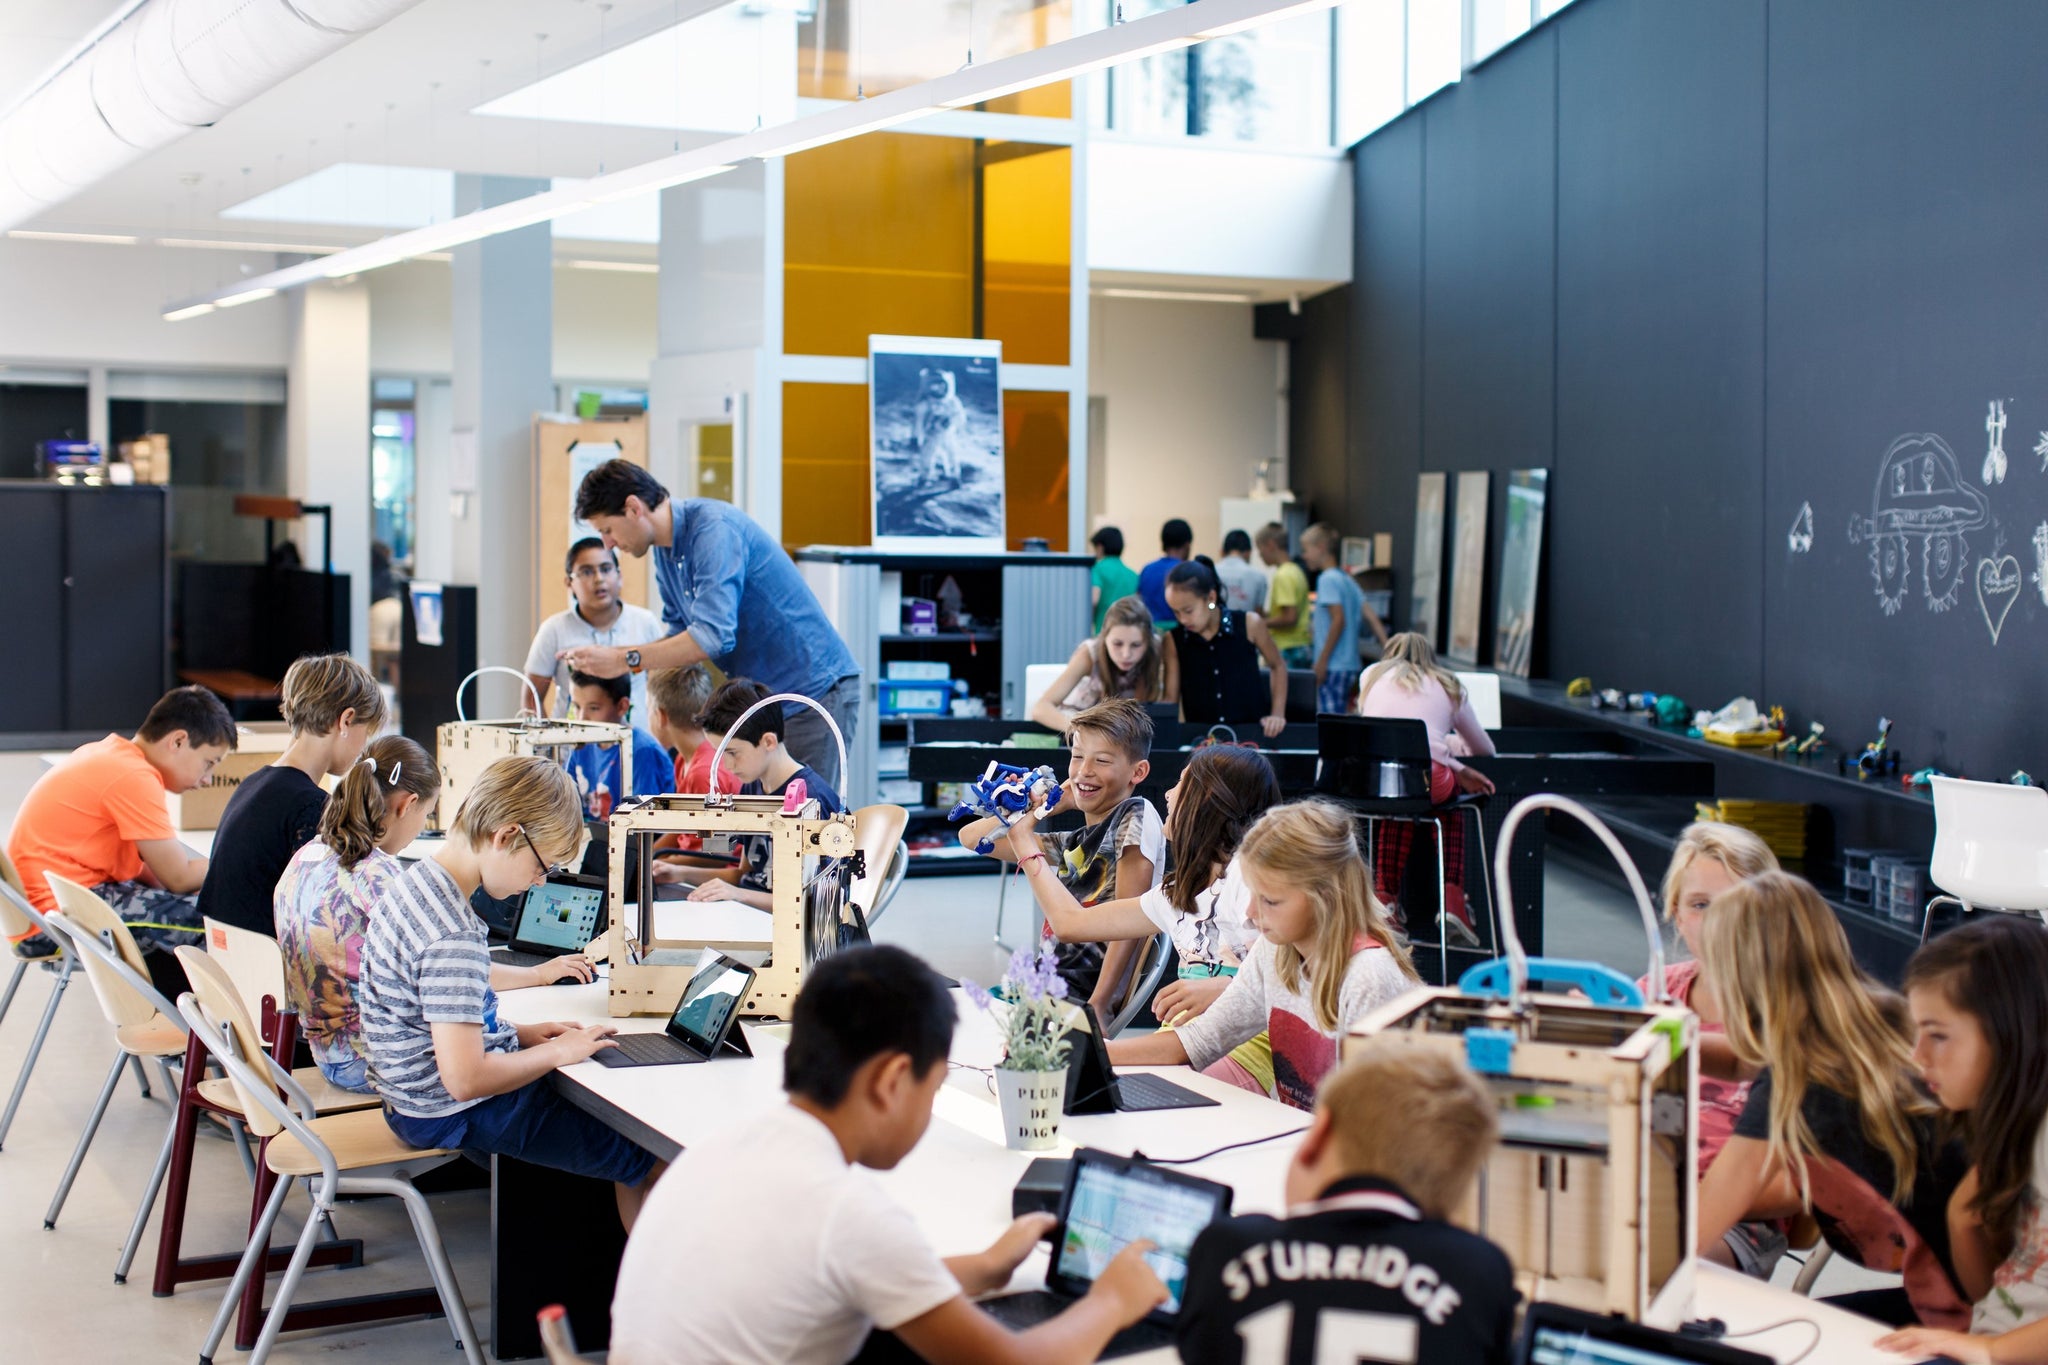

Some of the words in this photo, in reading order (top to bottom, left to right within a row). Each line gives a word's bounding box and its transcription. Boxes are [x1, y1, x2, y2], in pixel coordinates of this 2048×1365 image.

[1018, 1087, 1059, 1100] PLUK
[1031, 1109, 1048, 1120] DE
[1019, 1126, 1048, 1138] DAG
[1222, 1239, 1463, 1326] STURRIDGE
